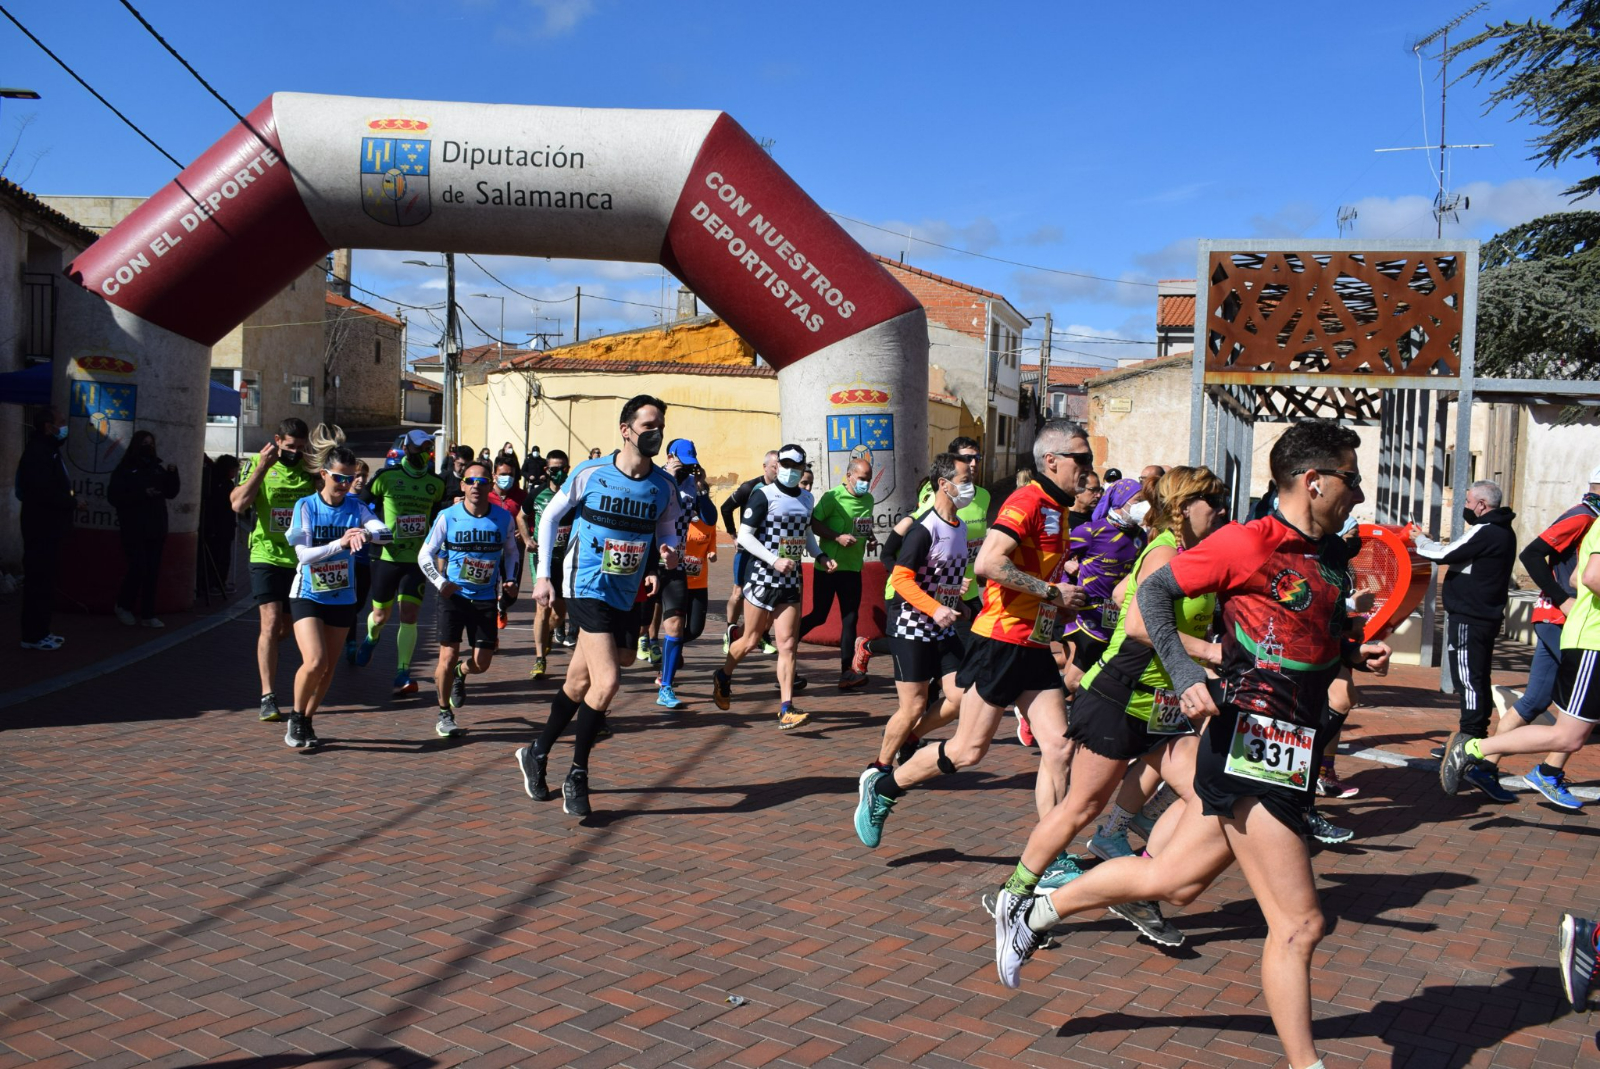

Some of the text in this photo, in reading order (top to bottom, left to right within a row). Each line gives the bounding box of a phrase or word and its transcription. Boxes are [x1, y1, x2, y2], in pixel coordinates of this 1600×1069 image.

[442, 140, 585, 170] Diputación
[442, 181, 613, 210] de Salamanca
[102, 147, 280, 296] CON EL DEPORTE
[705, 172, 856, 319] CON NUESTROS
[690, 201, 824, 333] DEPORTISTAS
[73, 478, 106, 497] uta
[600, 494, 658, 520] naturé
[402, 523, 421, 532] 362
[455, 528, 501, 542] naturé
[467, 566, 489, 579] 351
[612, 552, 639, 567] 335
[319, 571, 343, 584] 336
[1237, 714, 1312, 750] bedunia
[1246, 738, 1295, 772] 331
